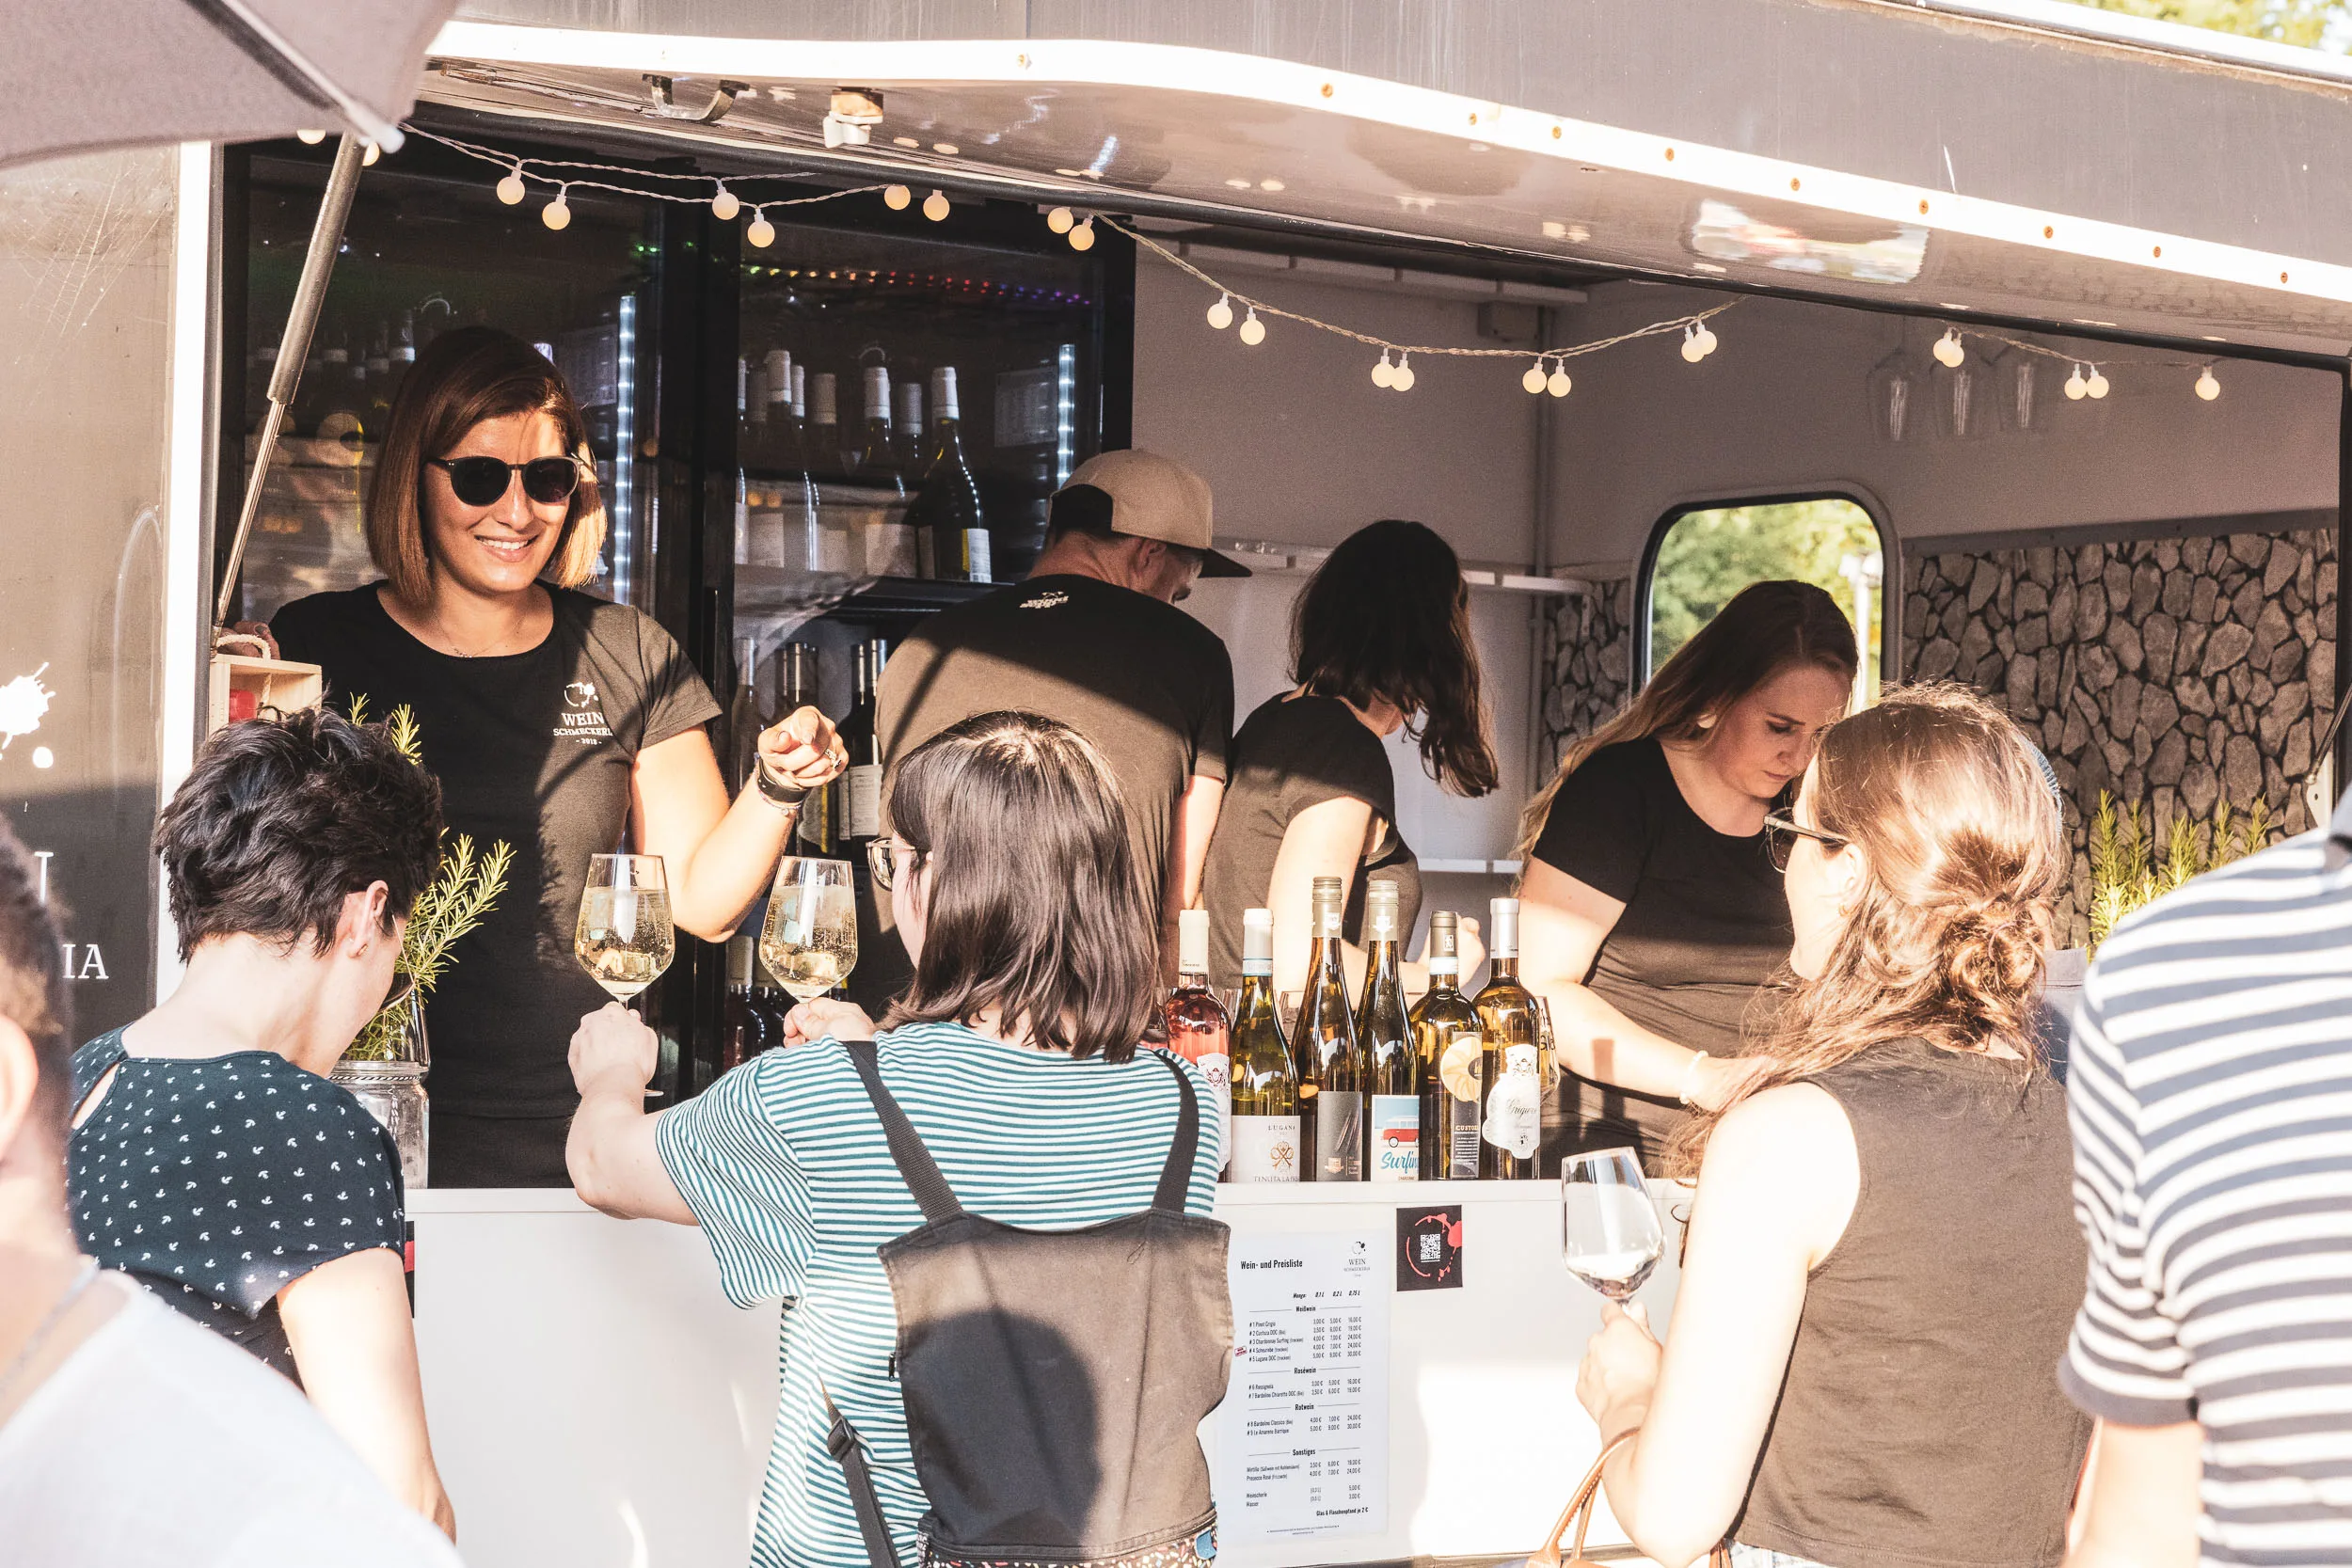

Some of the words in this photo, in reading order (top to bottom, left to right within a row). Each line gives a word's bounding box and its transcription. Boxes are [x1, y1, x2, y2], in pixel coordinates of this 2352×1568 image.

[561, 711, 605, 726] WEIN
[1381, 1150, 1420, 1174] Surfin
[1241, 1261, 1258, 1269] Wein-
[1260, 1260, 1271, 1268] und
[1273, 1259, 1303, 1268] Preisliste
